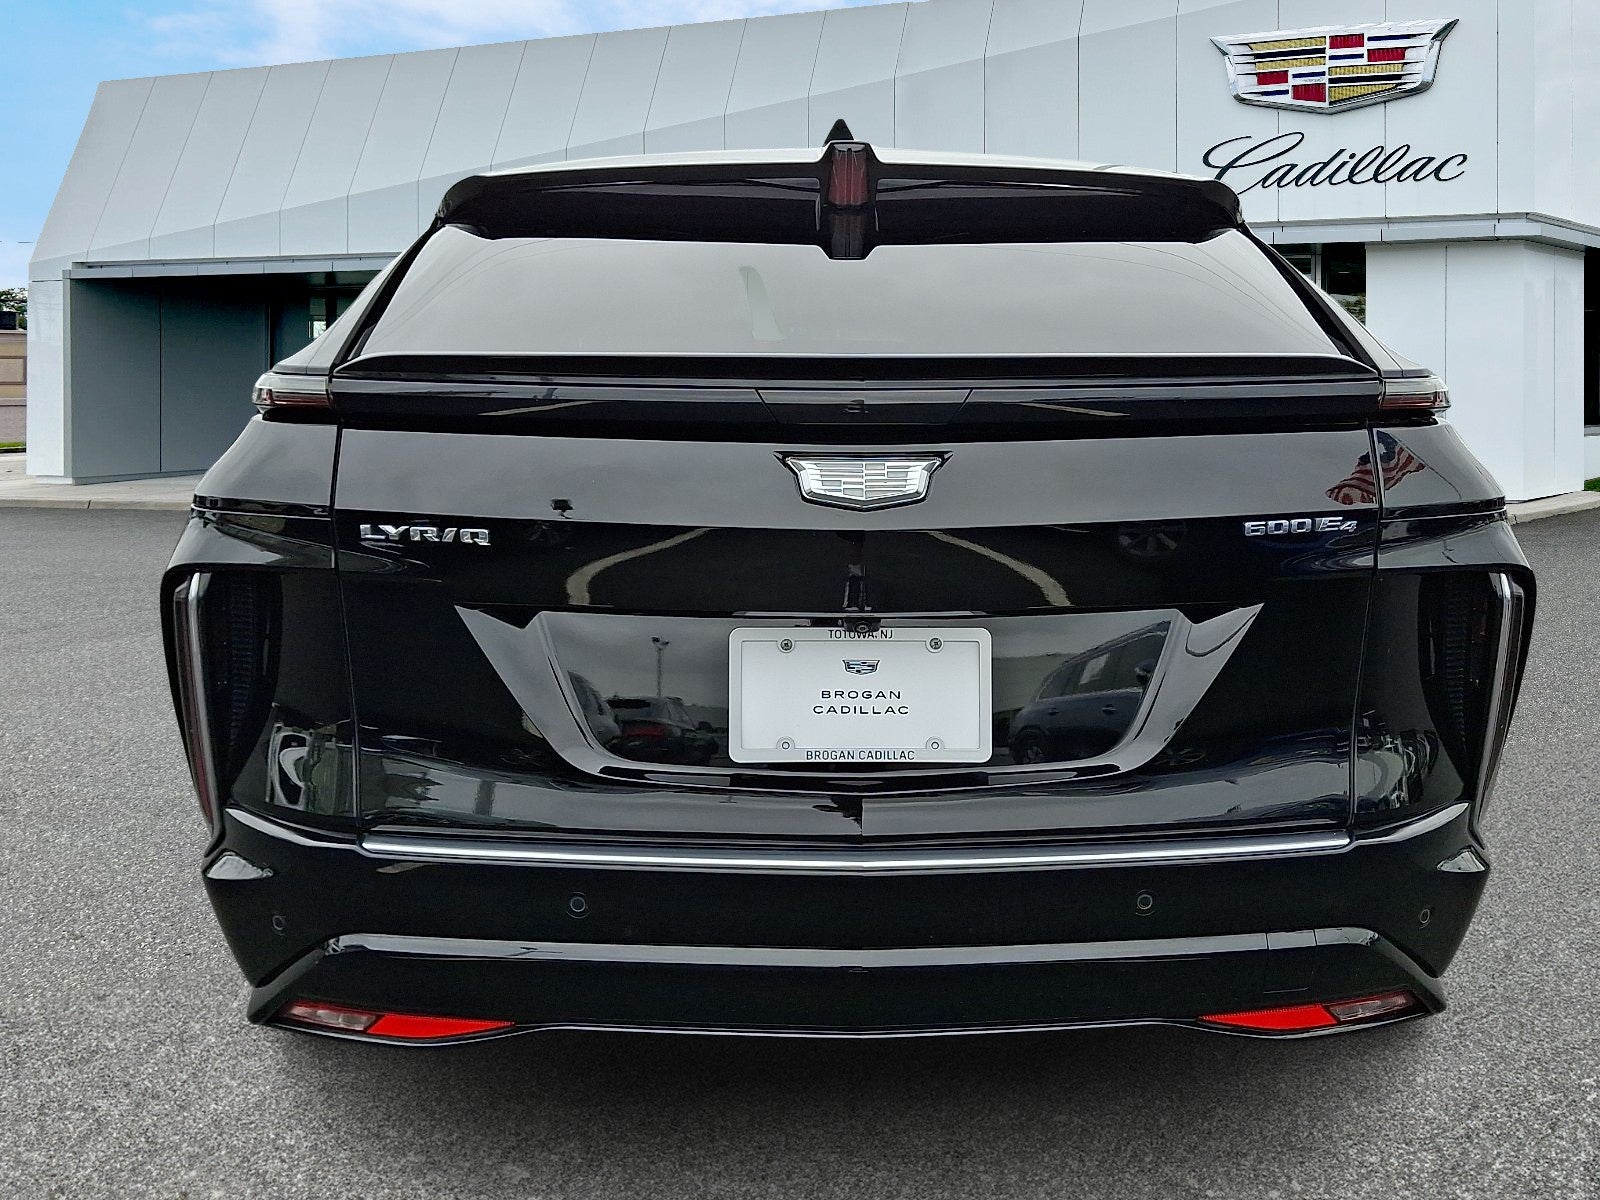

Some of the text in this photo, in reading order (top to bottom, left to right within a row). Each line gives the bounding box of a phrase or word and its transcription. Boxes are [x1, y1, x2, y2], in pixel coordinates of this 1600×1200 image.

[1202, 131, 1468, 195] Cadillac
[880, 629, 893, 639] NJ
[821, 690, 901, 699] BROGAN
[812, 705, 909, 715] CADILLAC
[806, 750, 915, 760] BROGAN CADILLAC
